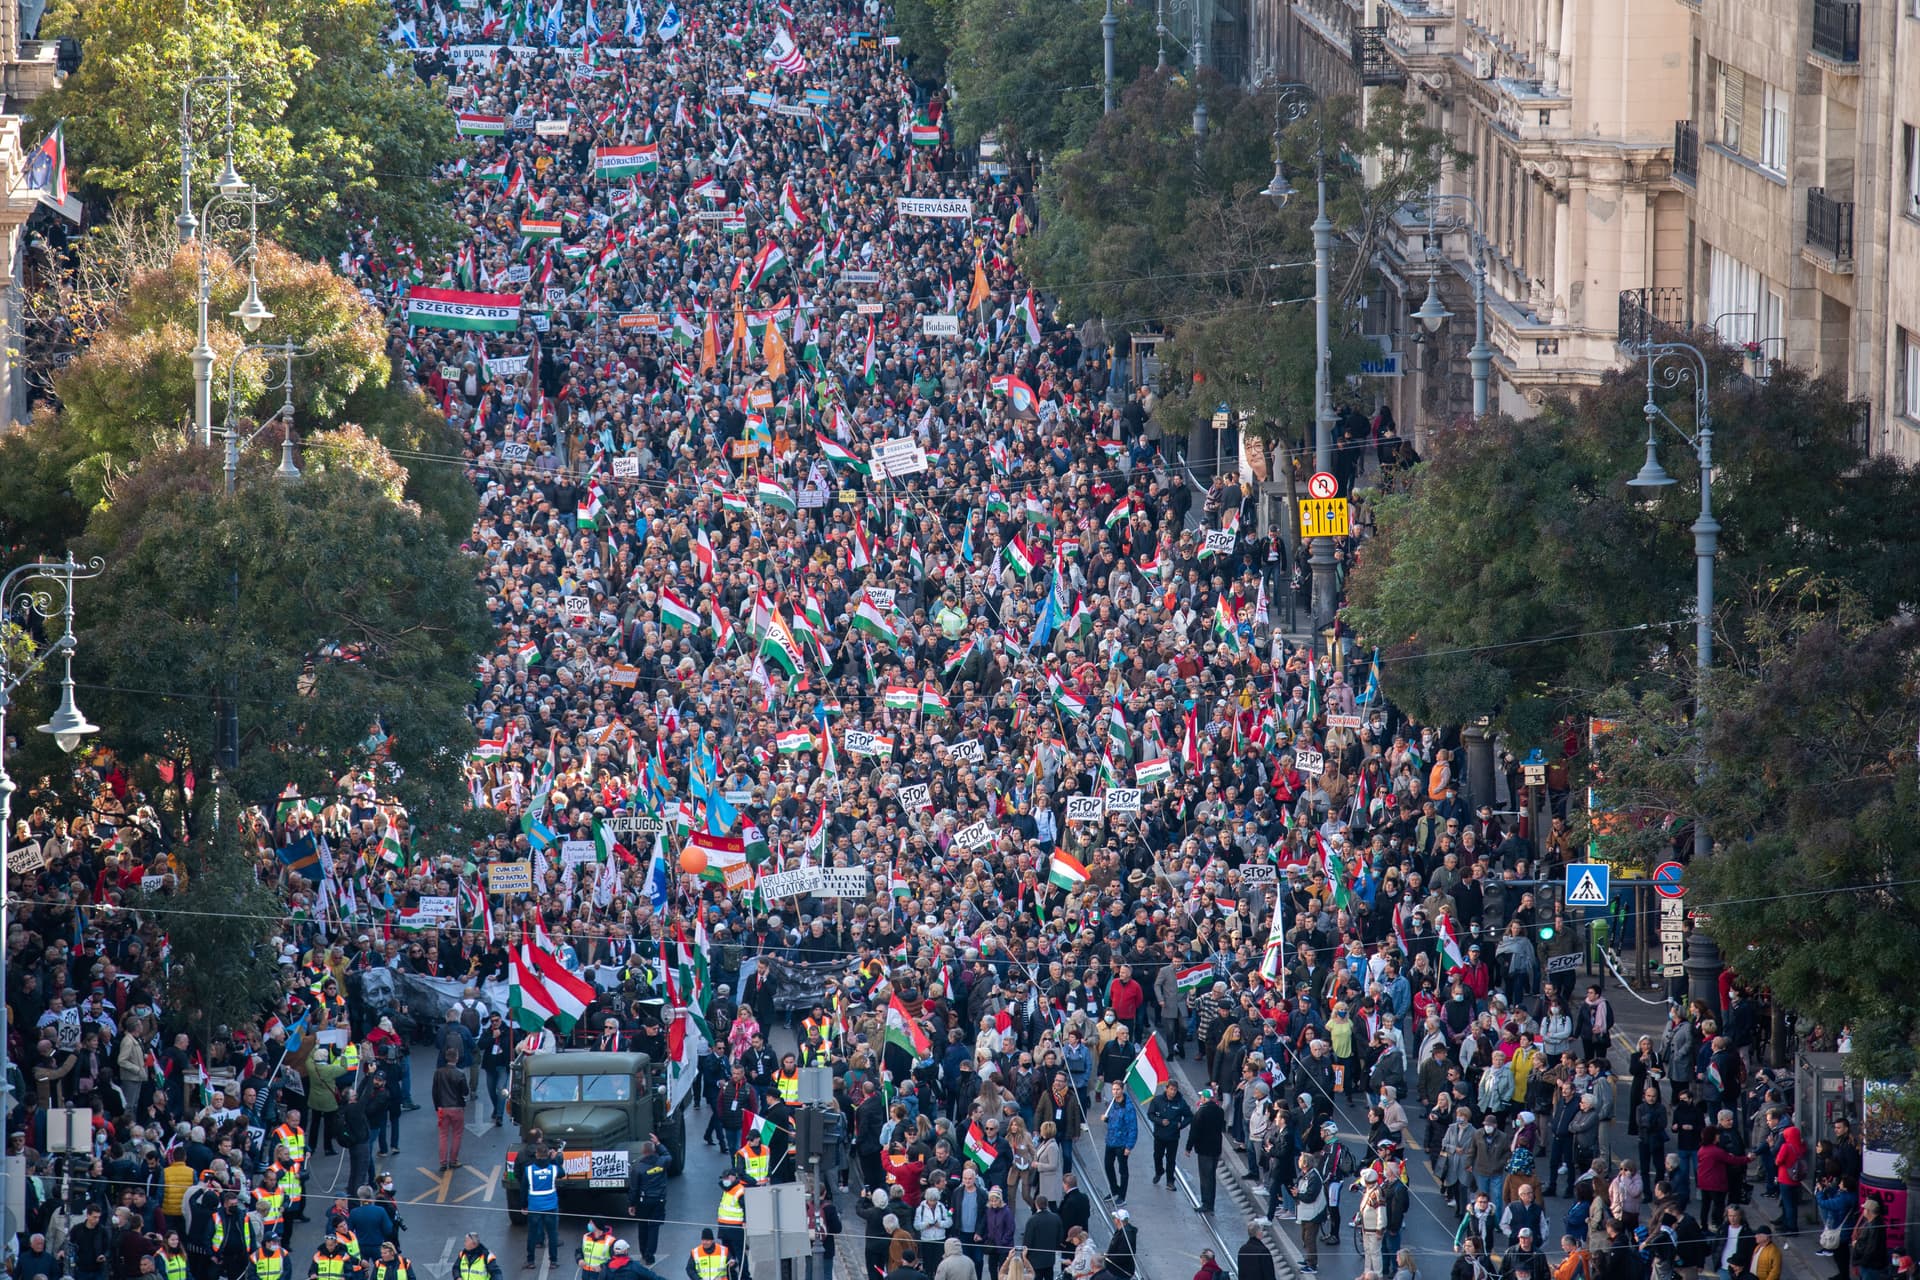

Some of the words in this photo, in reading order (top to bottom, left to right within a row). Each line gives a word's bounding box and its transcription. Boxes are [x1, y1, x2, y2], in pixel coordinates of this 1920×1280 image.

[1360, 357, 1396, 373] RIUM
[504, 443, 528, 456] STOP
[1208, 533, 1234, 546] STOP
[566, 600, 588, 611] STOP
[847, 733, 874, 749] STOP
[951, 741, 978, 758] STOP
[1298, 752, 1321, 765] STOP
[902, 785, 927, 803] STOP
[1108, 790, 1139, 803] STOP
[1069, 798, 1101, 813] STOP
[960, 821, 986, 849] STOP
[8, 848, 31, 866] SOHA
[763, 869, 807, 888] BRUSSELS
[1242, 865, 1274, 879] STOP
[765, 877, 821, 899] DICTATORSHIP
[1549, 953, 1581, 969] STOP
[59, 1026, 80, 1042] STOP
[592, 1152, 617, 1167] SOHA
